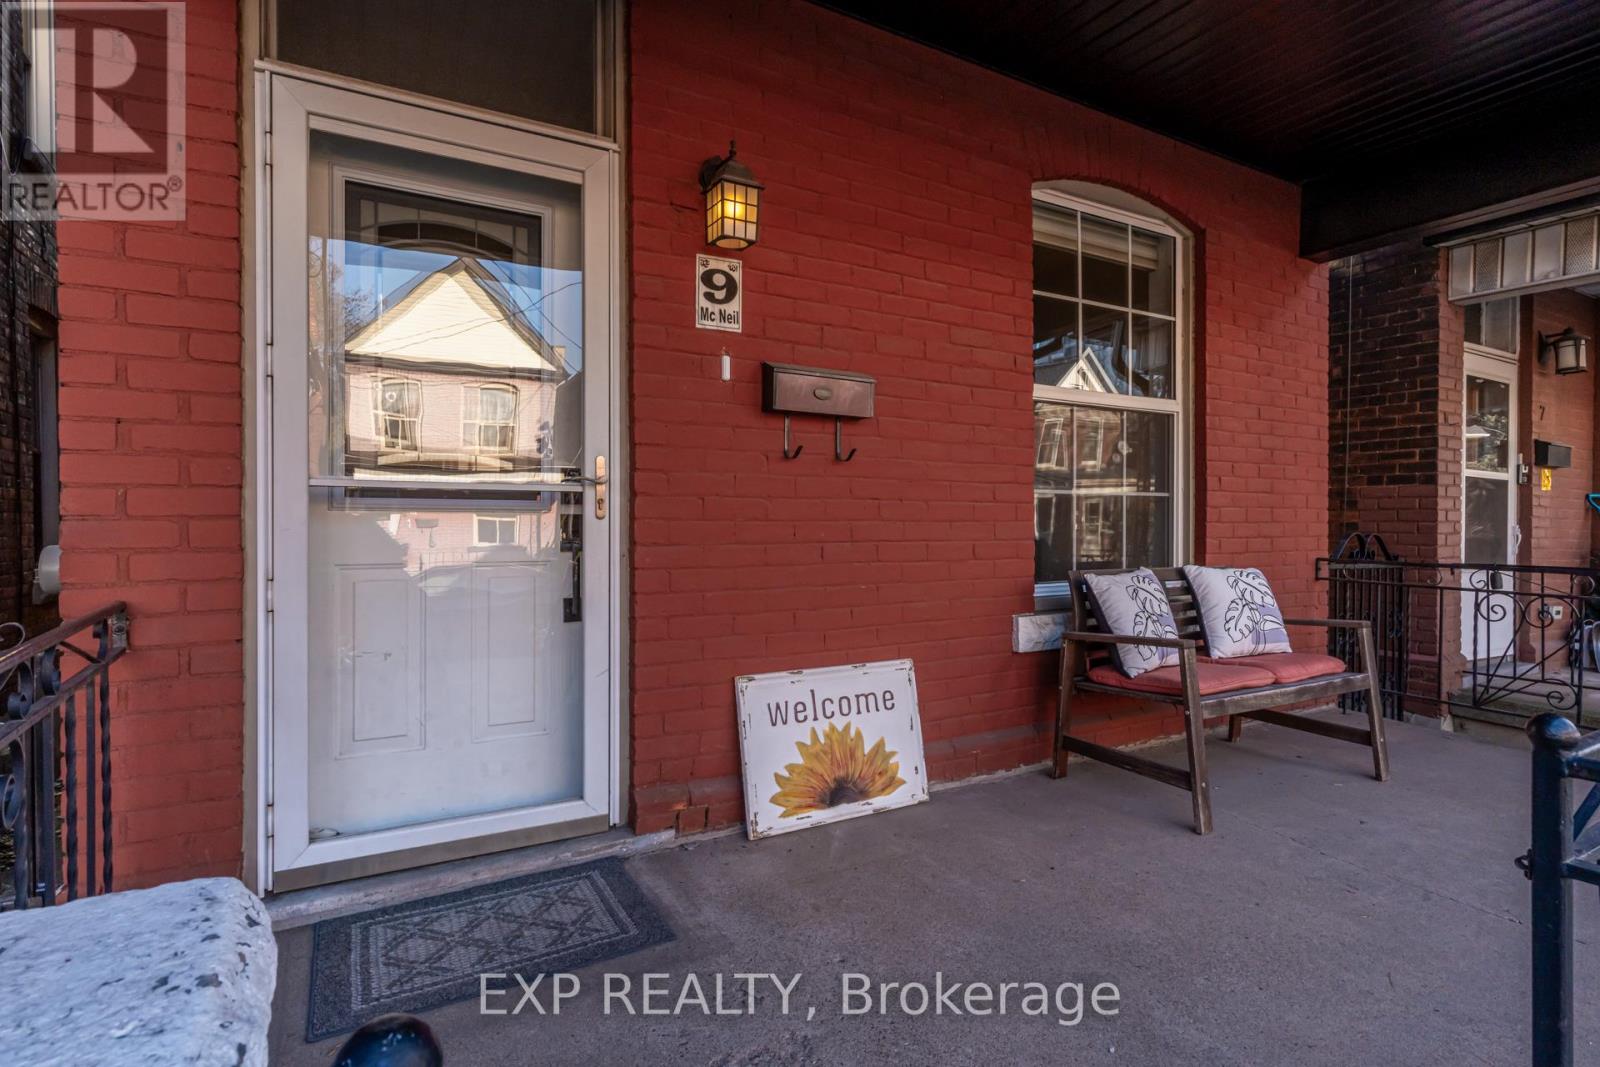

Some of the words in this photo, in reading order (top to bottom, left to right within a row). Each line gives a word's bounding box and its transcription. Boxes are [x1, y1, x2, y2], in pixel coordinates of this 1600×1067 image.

[702, 269, 737, 304] 9
[701, 307, 715, 322] Mc
[719, 309, 739, 324] Neil
[1539, 404, 1545, 420] 7
